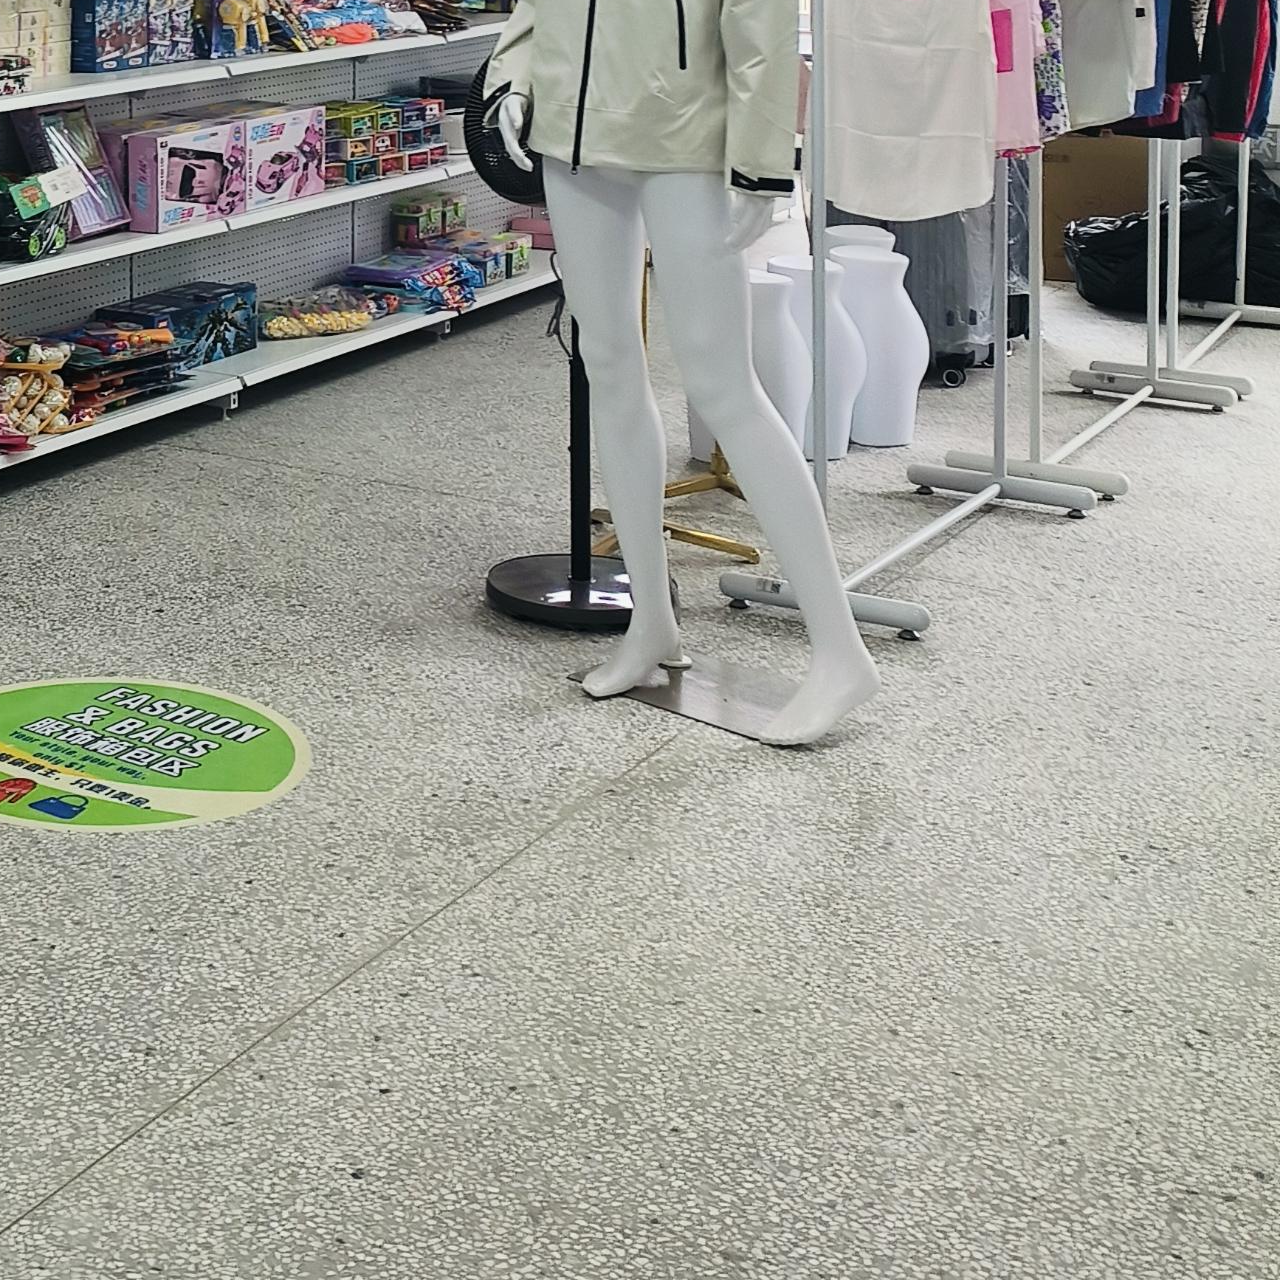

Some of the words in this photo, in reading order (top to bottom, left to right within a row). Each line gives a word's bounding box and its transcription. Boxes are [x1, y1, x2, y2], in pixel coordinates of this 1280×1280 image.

[63, 705, 114, 726] &
[104, 717, 222, 758] BAGS
[95, 686, 271, 744] FASHION
[20, 716, 202, 778] 服饰箱包区
[32, 751, 66, 766] only
[80, 754, 117, 770] your
